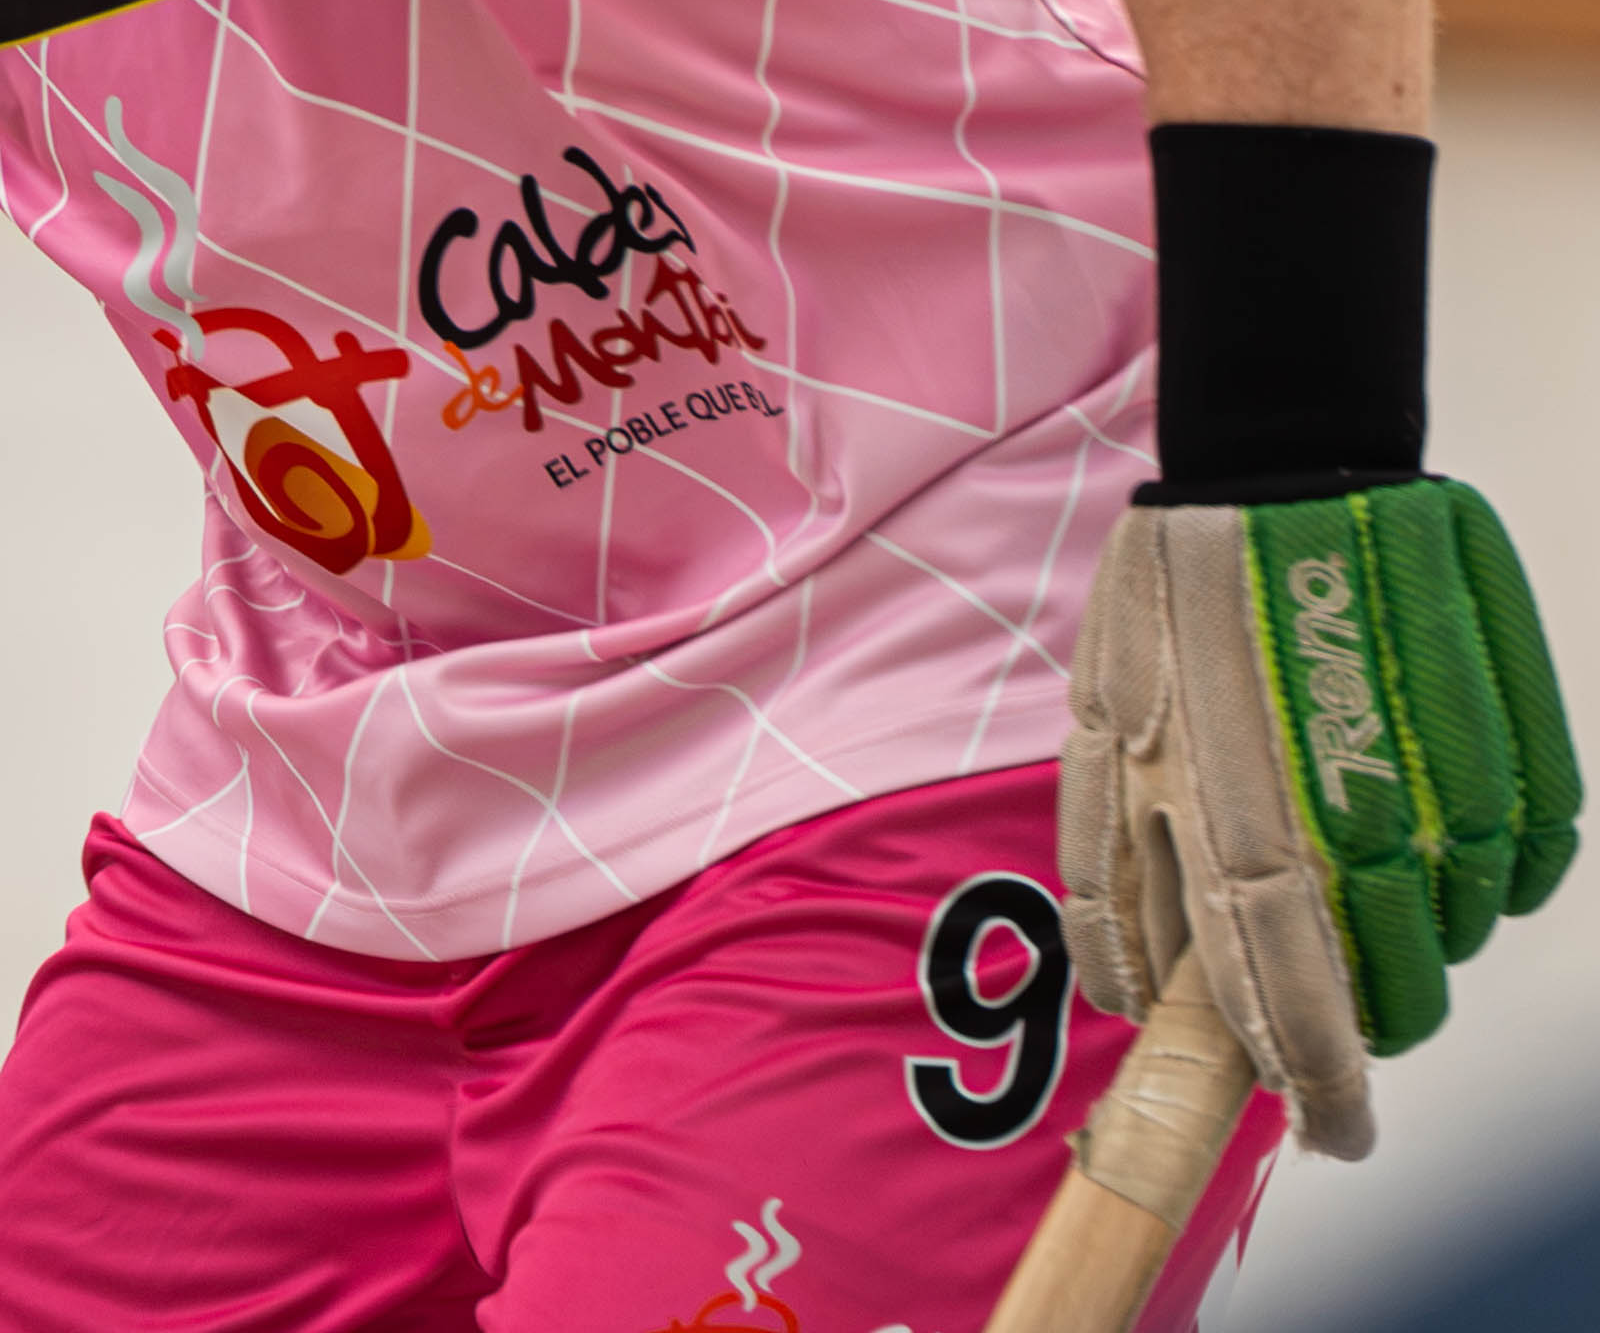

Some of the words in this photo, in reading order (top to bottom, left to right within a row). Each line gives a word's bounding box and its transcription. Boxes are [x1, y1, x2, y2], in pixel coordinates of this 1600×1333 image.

[442, 341, 524, 430] de
[544, 454, 590, 489] EL
[584, 401, 688, 467] POBLE
[685, 383, 747, 421] QUE
[905, 872, 1076, 1150] 9
